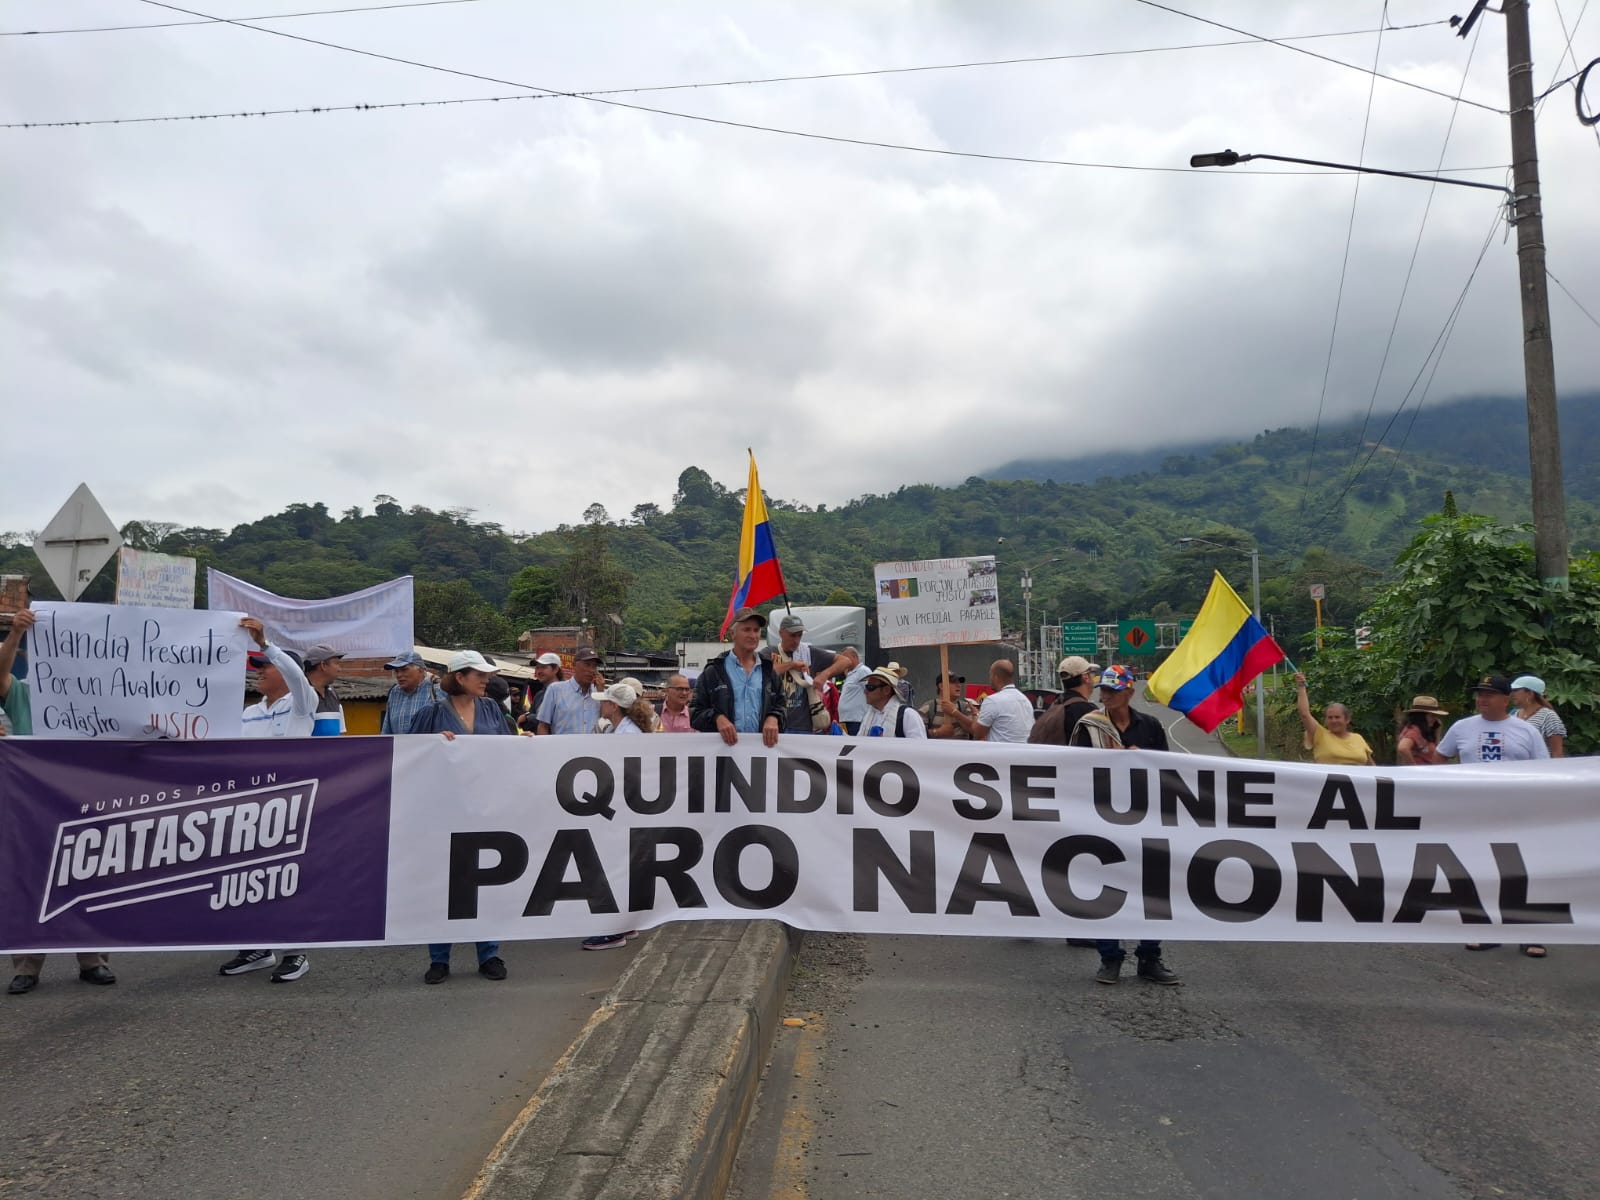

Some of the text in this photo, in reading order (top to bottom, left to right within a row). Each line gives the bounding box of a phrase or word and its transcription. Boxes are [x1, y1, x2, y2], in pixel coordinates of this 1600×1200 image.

[919, 580, 937, 593] POR
[896, 614, 910, 626] UN
[915, 610, 952, 625] PREDIAL
[143, 619, 230, 666] Presente
[35, 661, 209, 707] Por un Avalúo y
[43, 702, 120, 737] Catastro
[80, 772, 278, 815] #UNIDOS POR UN
[555, 745, 1422, 831] QUINDÍO SE UNE AL
[57, 793, 303, 886] ¡CATASTRO!
[209, 862, 300, 911] JUSTO
[448, 824, 1574, 924] PARO NACIONAL
